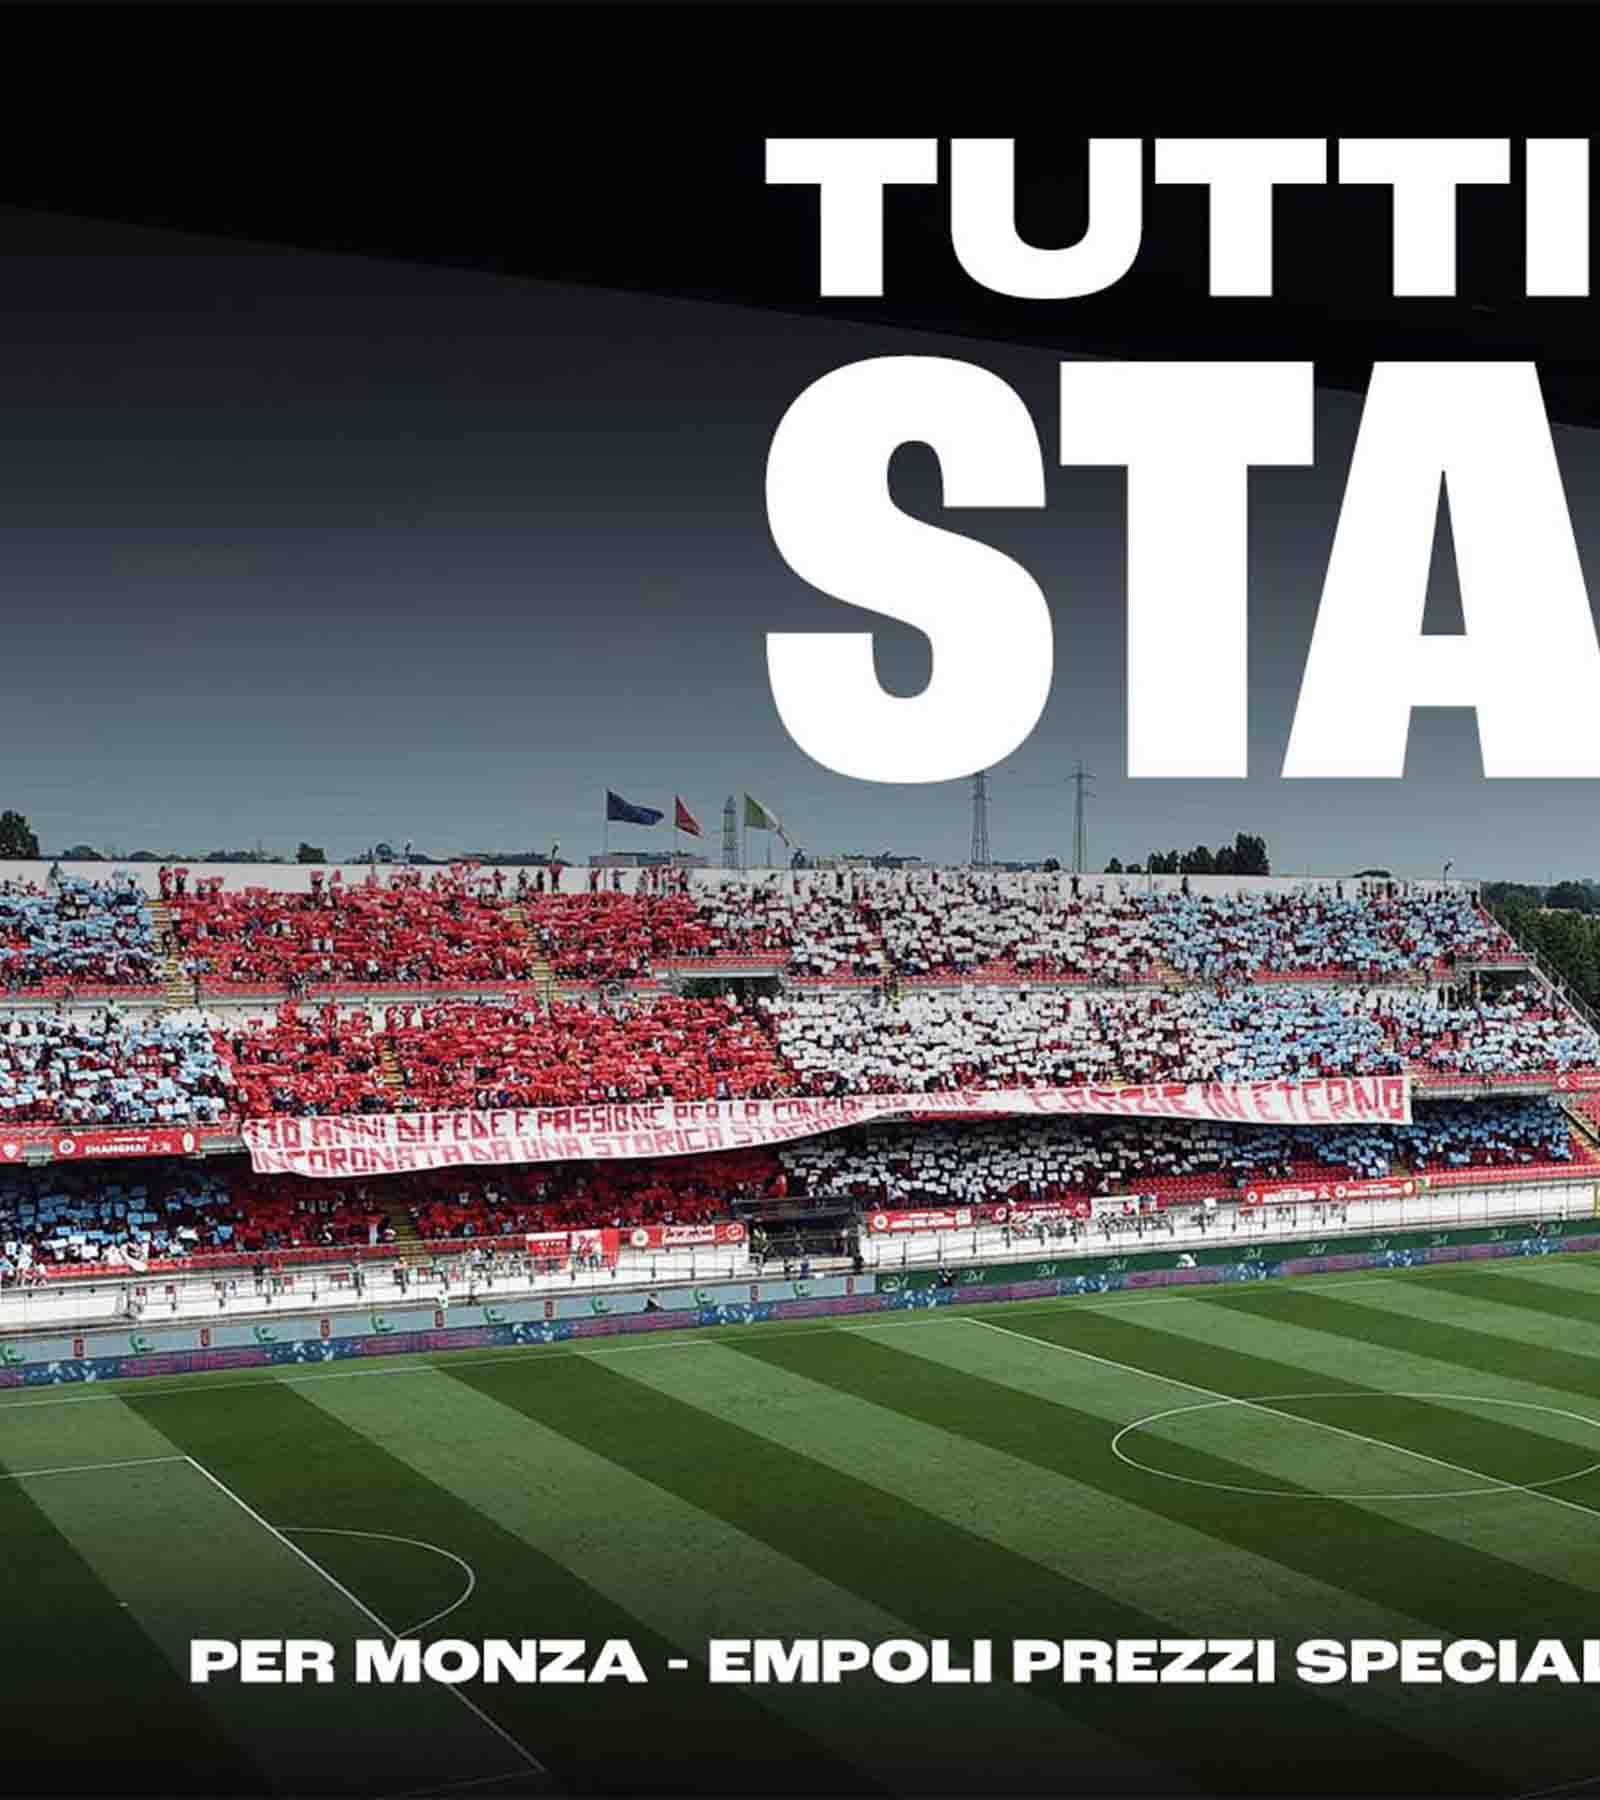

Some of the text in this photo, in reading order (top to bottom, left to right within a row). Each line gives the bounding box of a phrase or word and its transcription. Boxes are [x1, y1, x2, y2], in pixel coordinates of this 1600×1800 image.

[432, 1112, 507, 1142] FEDE
[537, 1104, 666, 1136] PASSIONE
[1200, 1082, 1250, 1120] IN
[1250, 1077, 1406, 1121] ETERNO
[517, 1135, 585, 1159] UNA
[590, 1126, 723, 1157] STORICA
